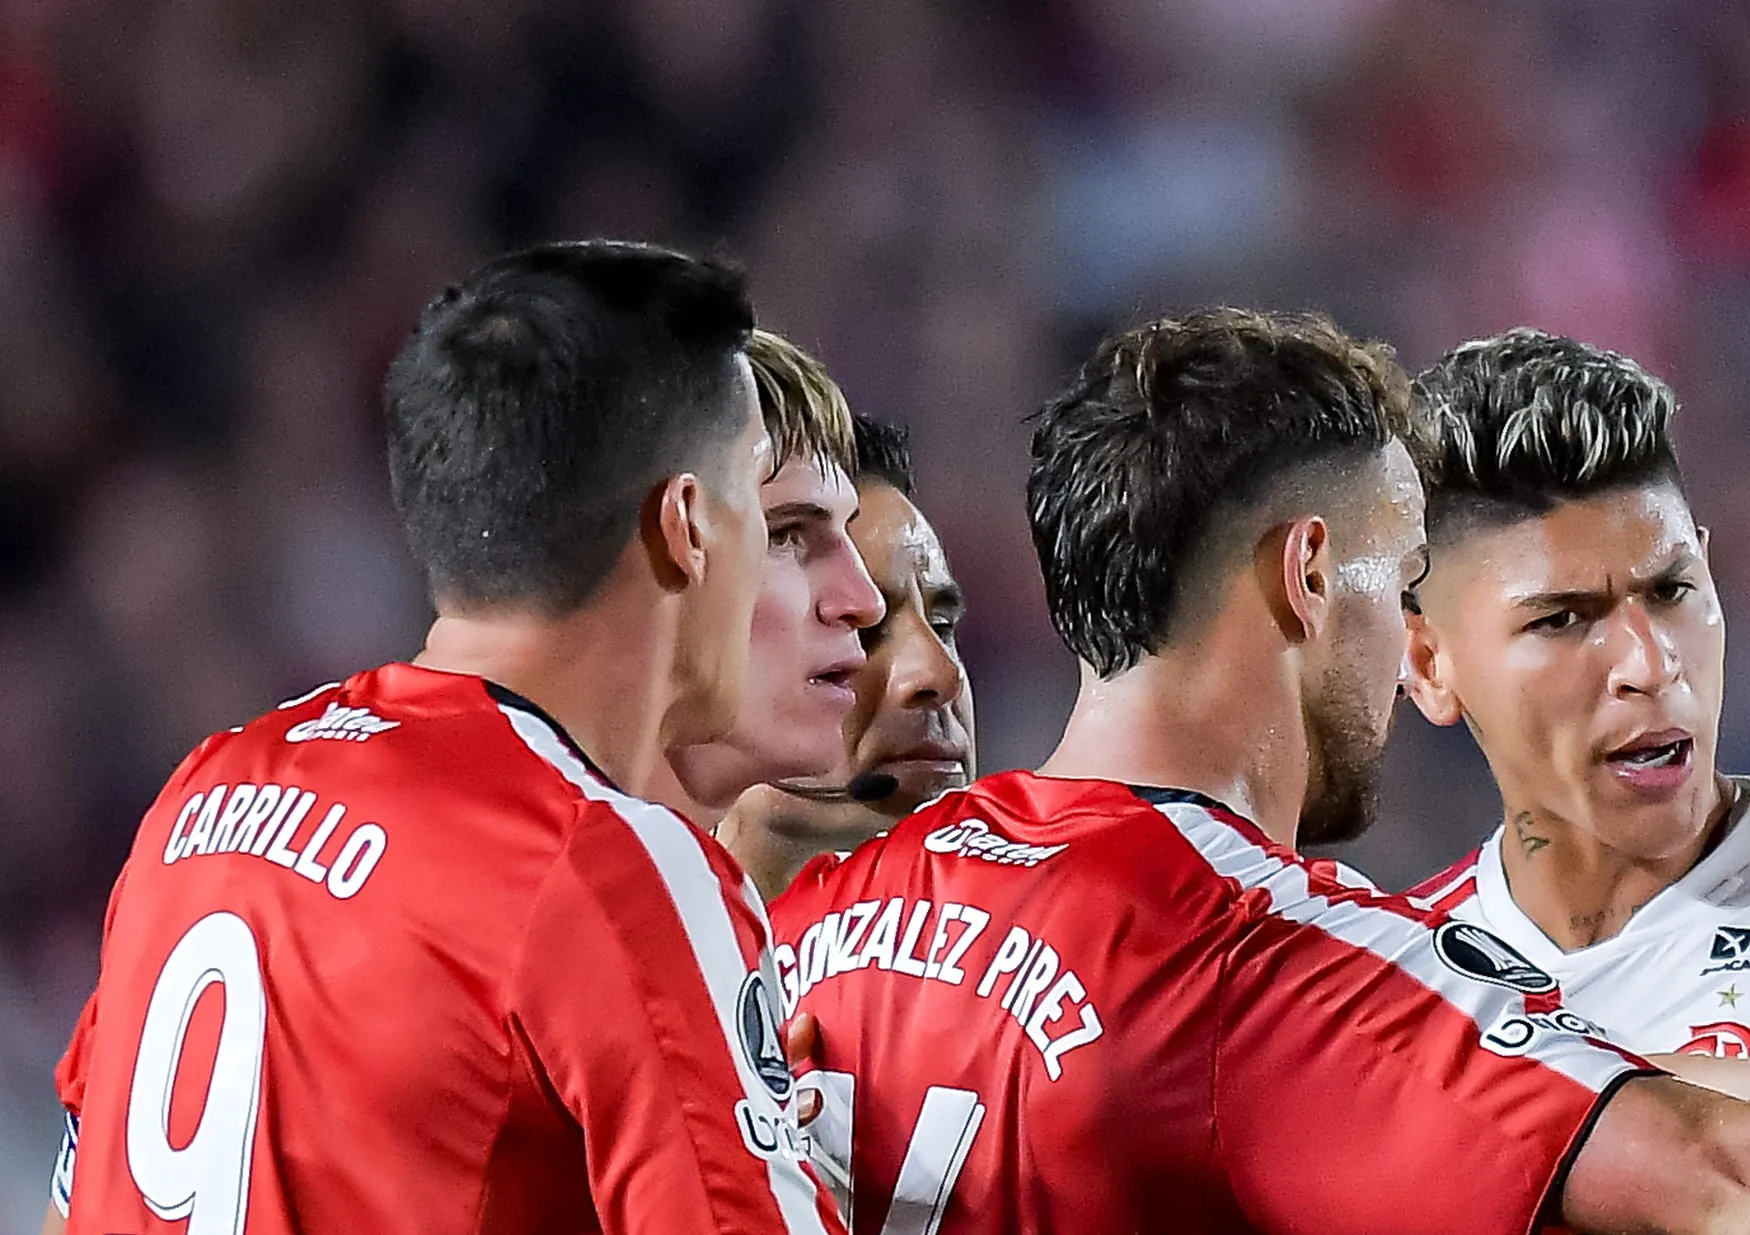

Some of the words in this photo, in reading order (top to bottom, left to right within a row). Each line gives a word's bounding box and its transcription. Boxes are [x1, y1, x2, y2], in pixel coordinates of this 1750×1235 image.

[162, 783, 388, 900] CARRILLO
[776, 898, 992, 1021] GONZALEZ
[977, 925, 1102, 1081] PIREZ
